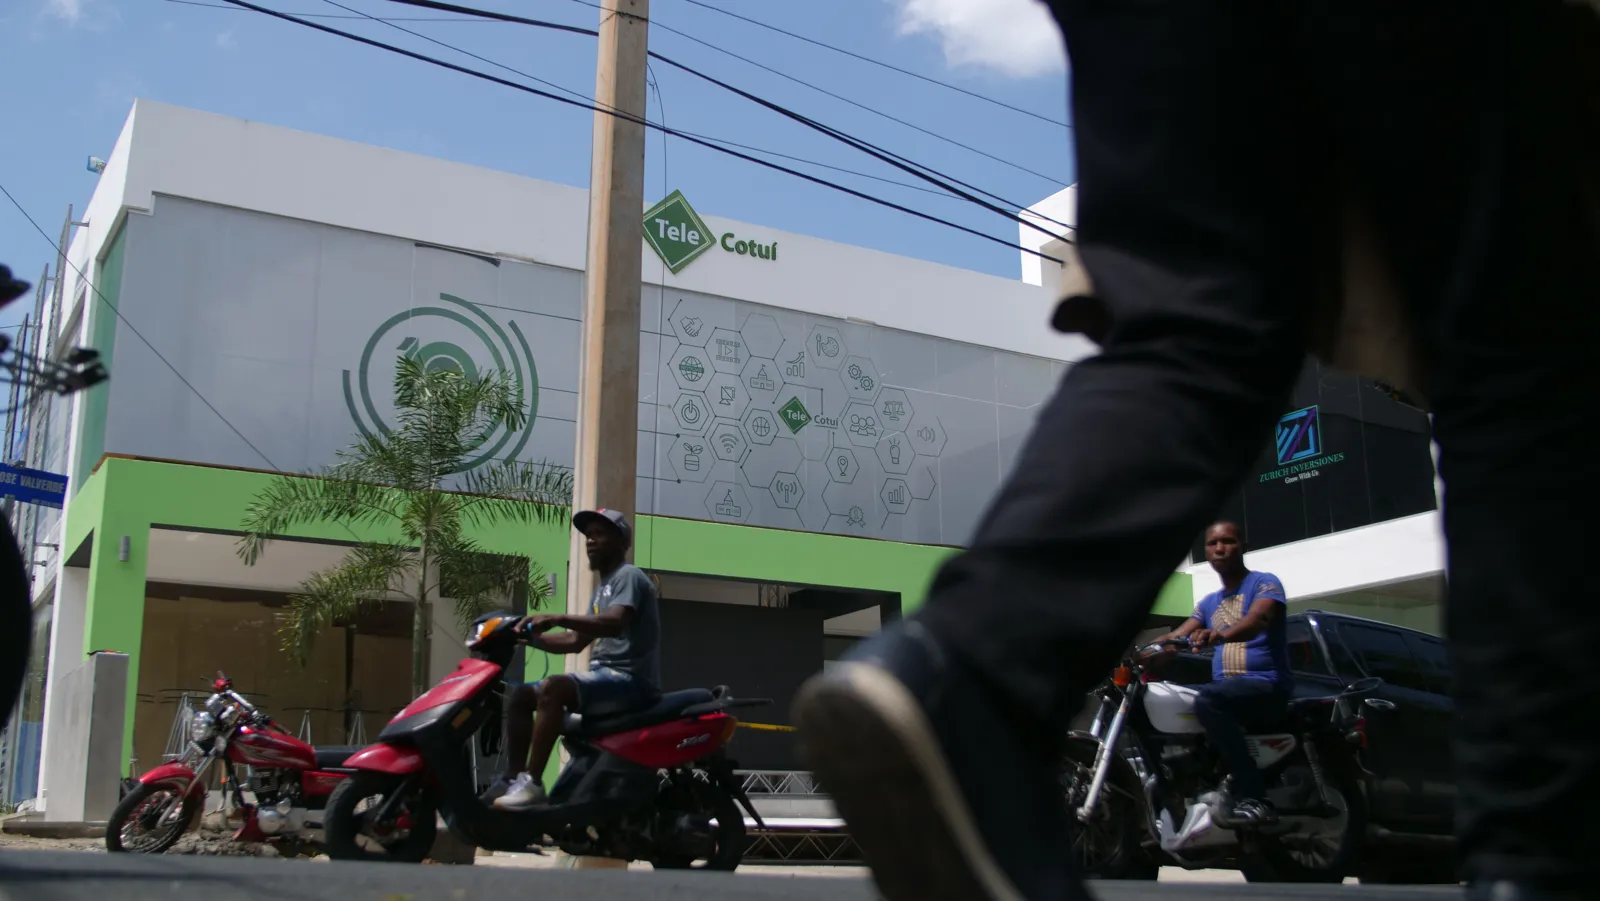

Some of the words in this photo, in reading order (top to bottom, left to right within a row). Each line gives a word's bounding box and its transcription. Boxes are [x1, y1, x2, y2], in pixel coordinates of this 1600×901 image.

[655, 218, 700, 246] Tele
[720, 232, 777, 261] Cotuí
[786, 409, 806, 421] Tele
[1259, 468, 1289, 483] ZURICH
[1290, 452, 1344, 474] INVERSIONES
[1284, 476, 1299, 484] Grow
[1298, 471, 1311, 480] With
[1311, 469, 1319, 477] Us
[0, 471, 17, 485] OSE
[20, 475, 65, 494] VALVERDE
